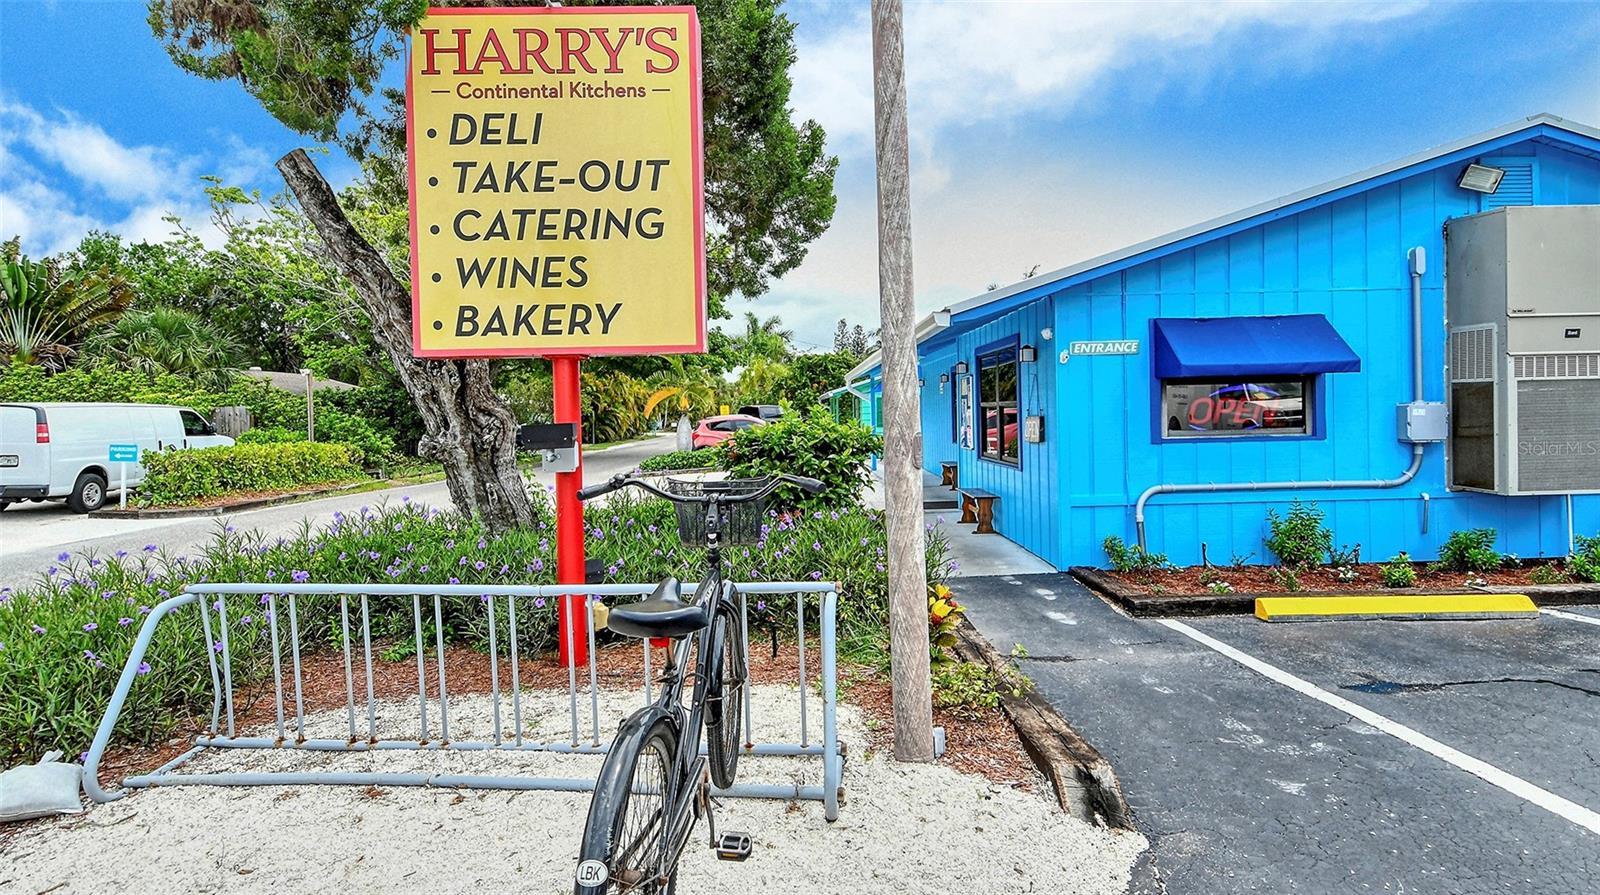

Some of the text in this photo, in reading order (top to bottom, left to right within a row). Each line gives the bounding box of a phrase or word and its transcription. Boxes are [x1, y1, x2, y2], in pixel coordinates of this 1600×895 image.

[420, 27, 680, 75] HARRY'S
[456, 80, 646, 99] Continental Kitchens
[449, 113, 543, 145] DELI
[453, 160, 670, 194] TAKE-OUT
[453, 208, 665, 241] CATERING
[457, 256, 588, 289] WINES
[455, 303, 622, 337] BAKERY
[1073, 342, 1138, 353] ENTRANCE
[1187, 396, 1278, 425] OPEN
[580, 866, 601, 880] LBK
